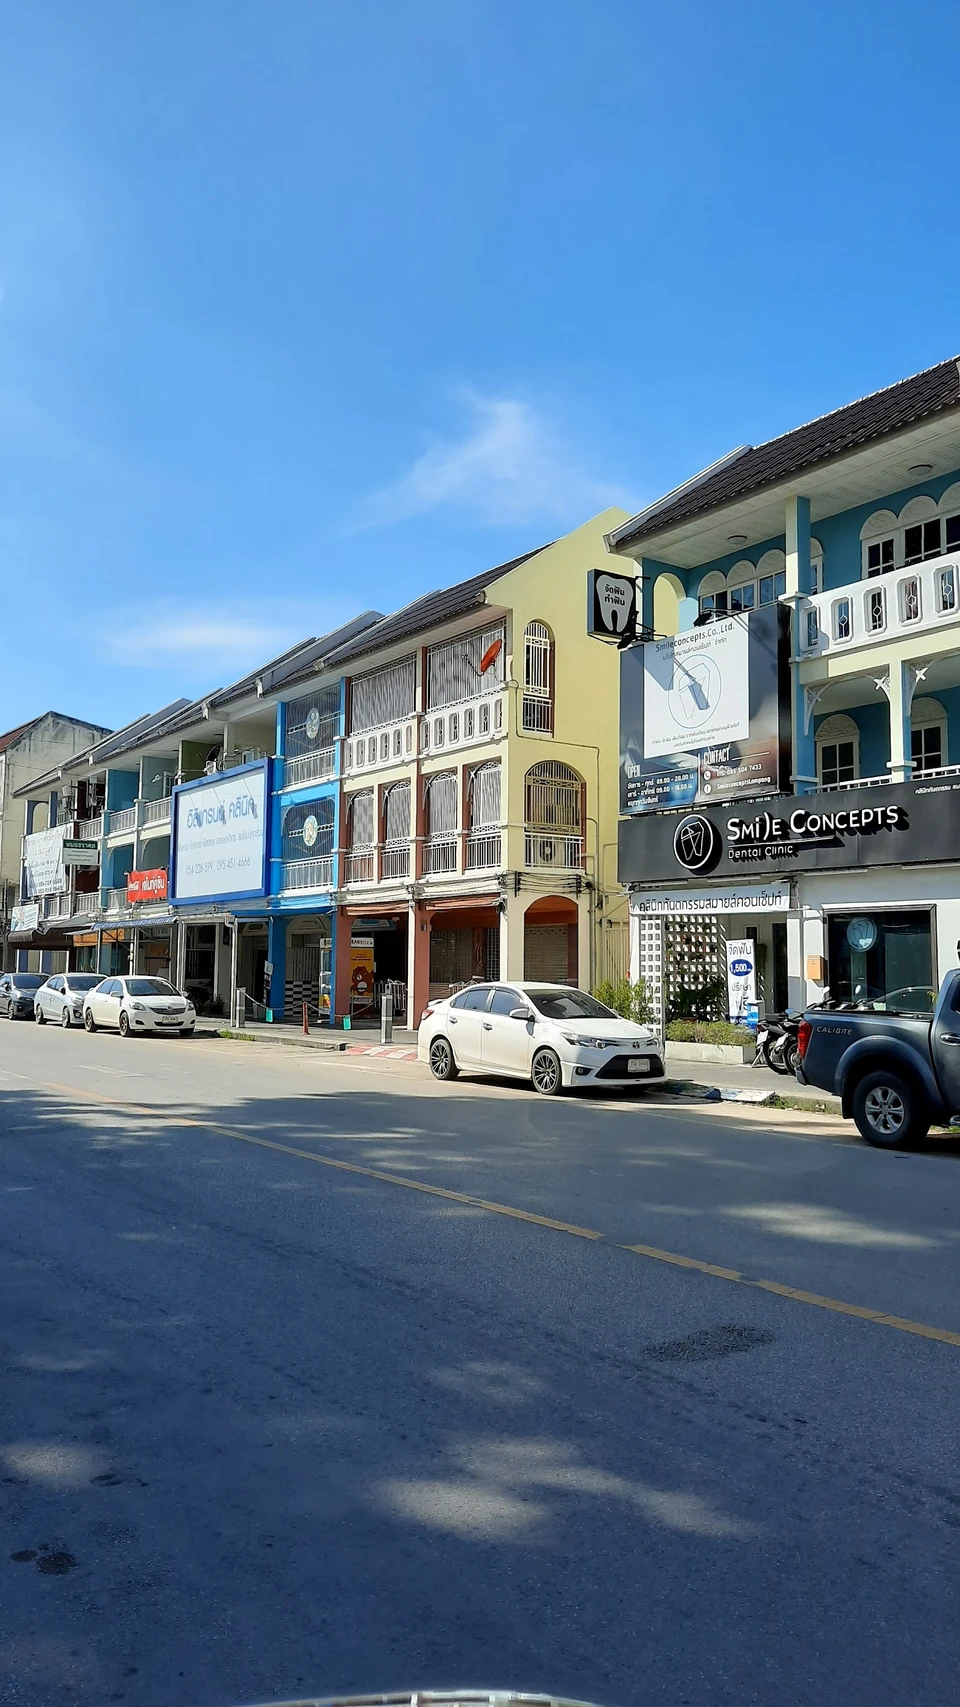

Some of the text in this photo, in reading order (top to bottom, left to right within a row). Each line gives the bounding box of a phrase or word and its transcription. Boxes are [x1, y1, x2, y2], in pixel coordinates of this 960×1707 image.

[604, 583, 625, 596] จัดฟัน
[604, 594, 626, 606] ทำฟัน
[703, 747, 730, 765] CONTACT
[627, 764, 641, 779] OPEN
[728, 845, 793, 859] Dental Clinic
[728, 943, 752, 955] จัดฟัน
[731, 981, 752, 992] ปรึกษา
[816, 1026, 853, 1036] CALIBRE
